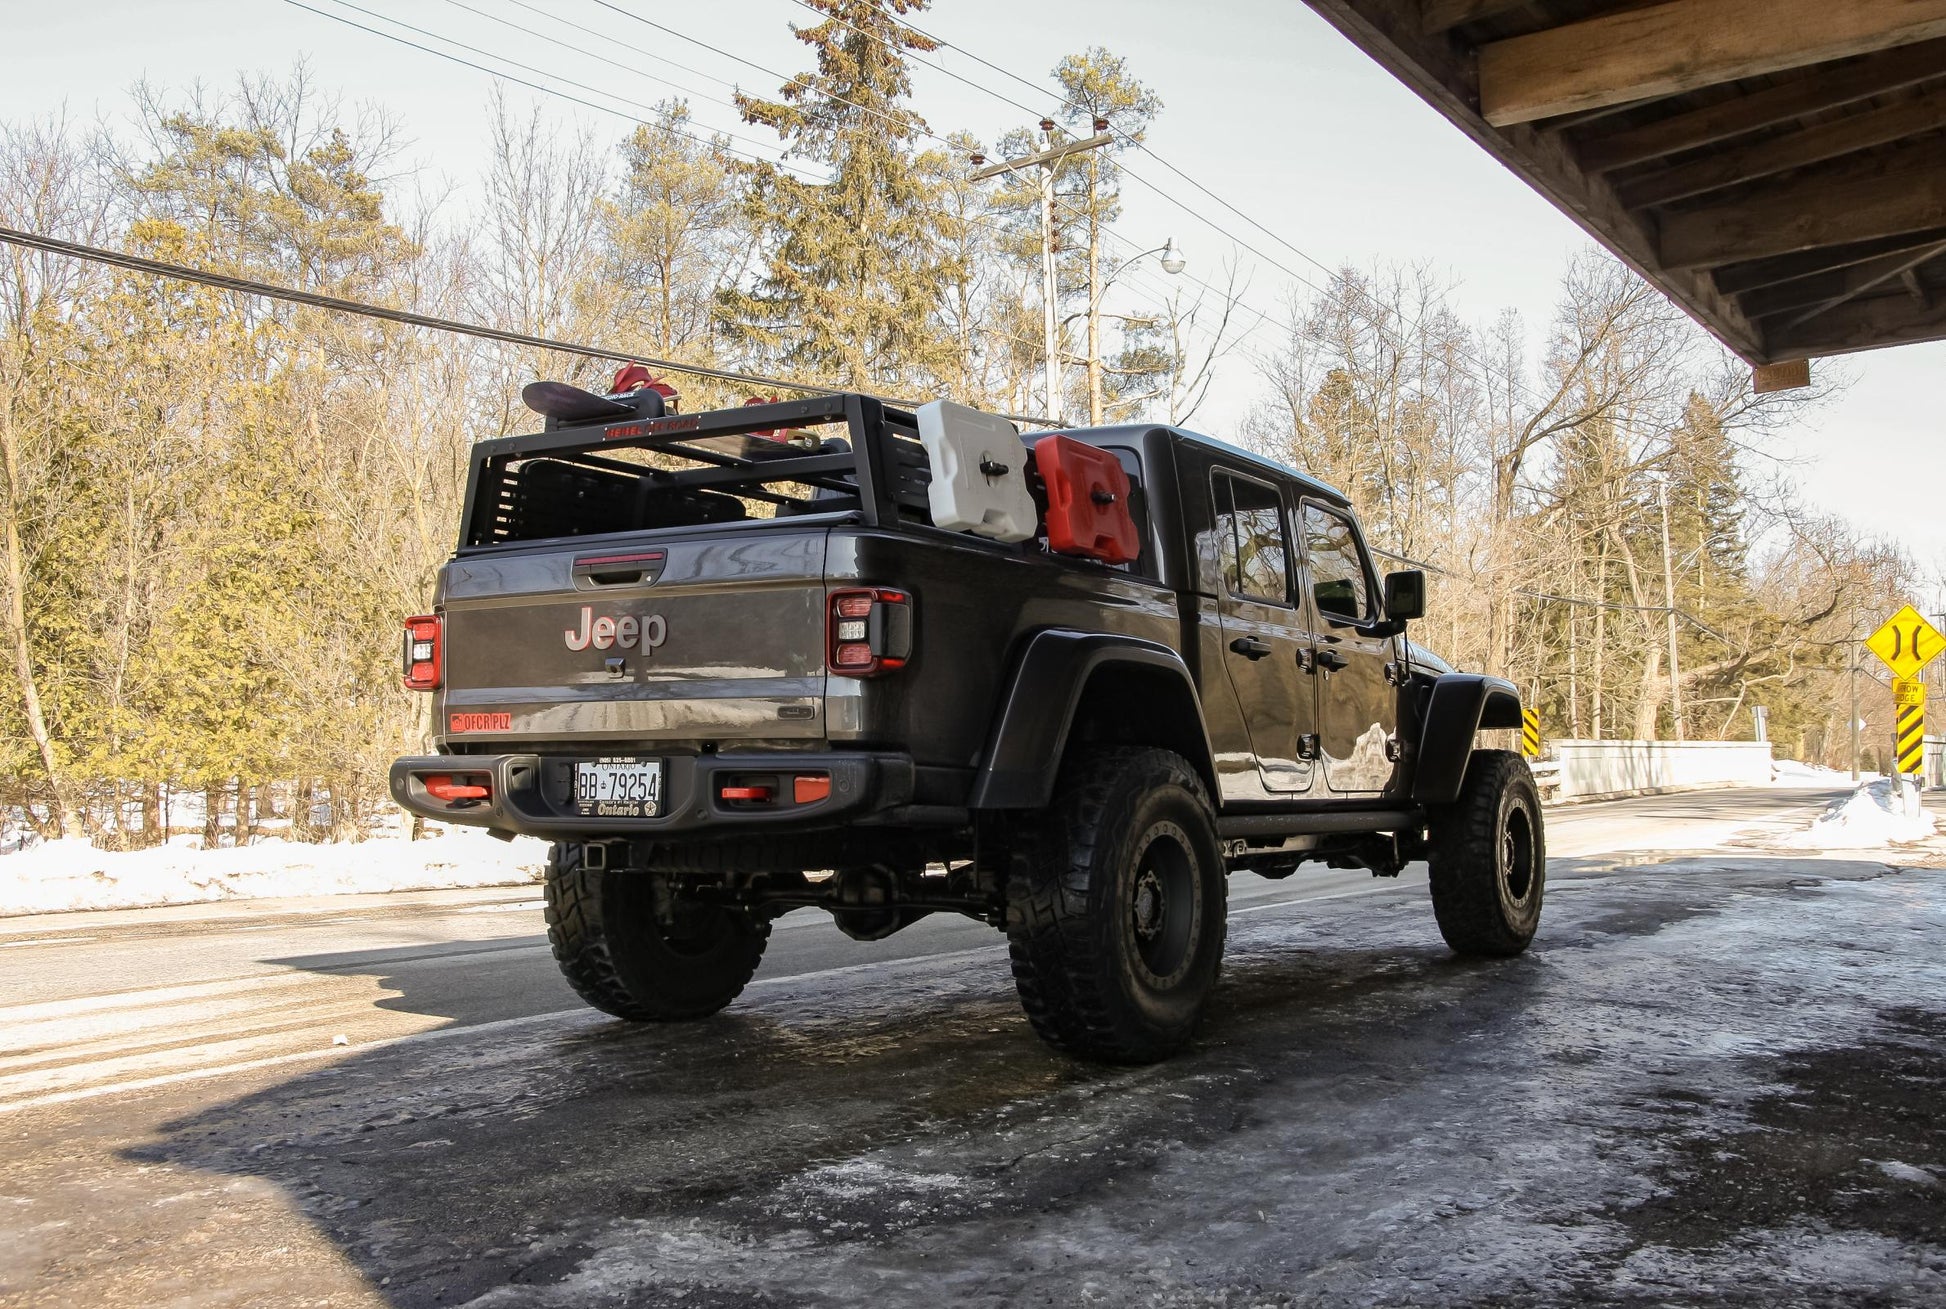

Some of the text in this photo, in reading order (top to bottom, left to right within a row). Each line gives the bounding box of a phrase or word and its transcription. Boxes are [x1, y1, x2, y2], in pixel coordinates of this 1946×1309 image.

[564, 606, 667, 657] Jeep
[464, 714, 510, 730] OFCR PLZ
[579, 773, 598, 800] BB
[609, 773, 657, 801] 79254
[597, 803, 640, 816] Ontario
